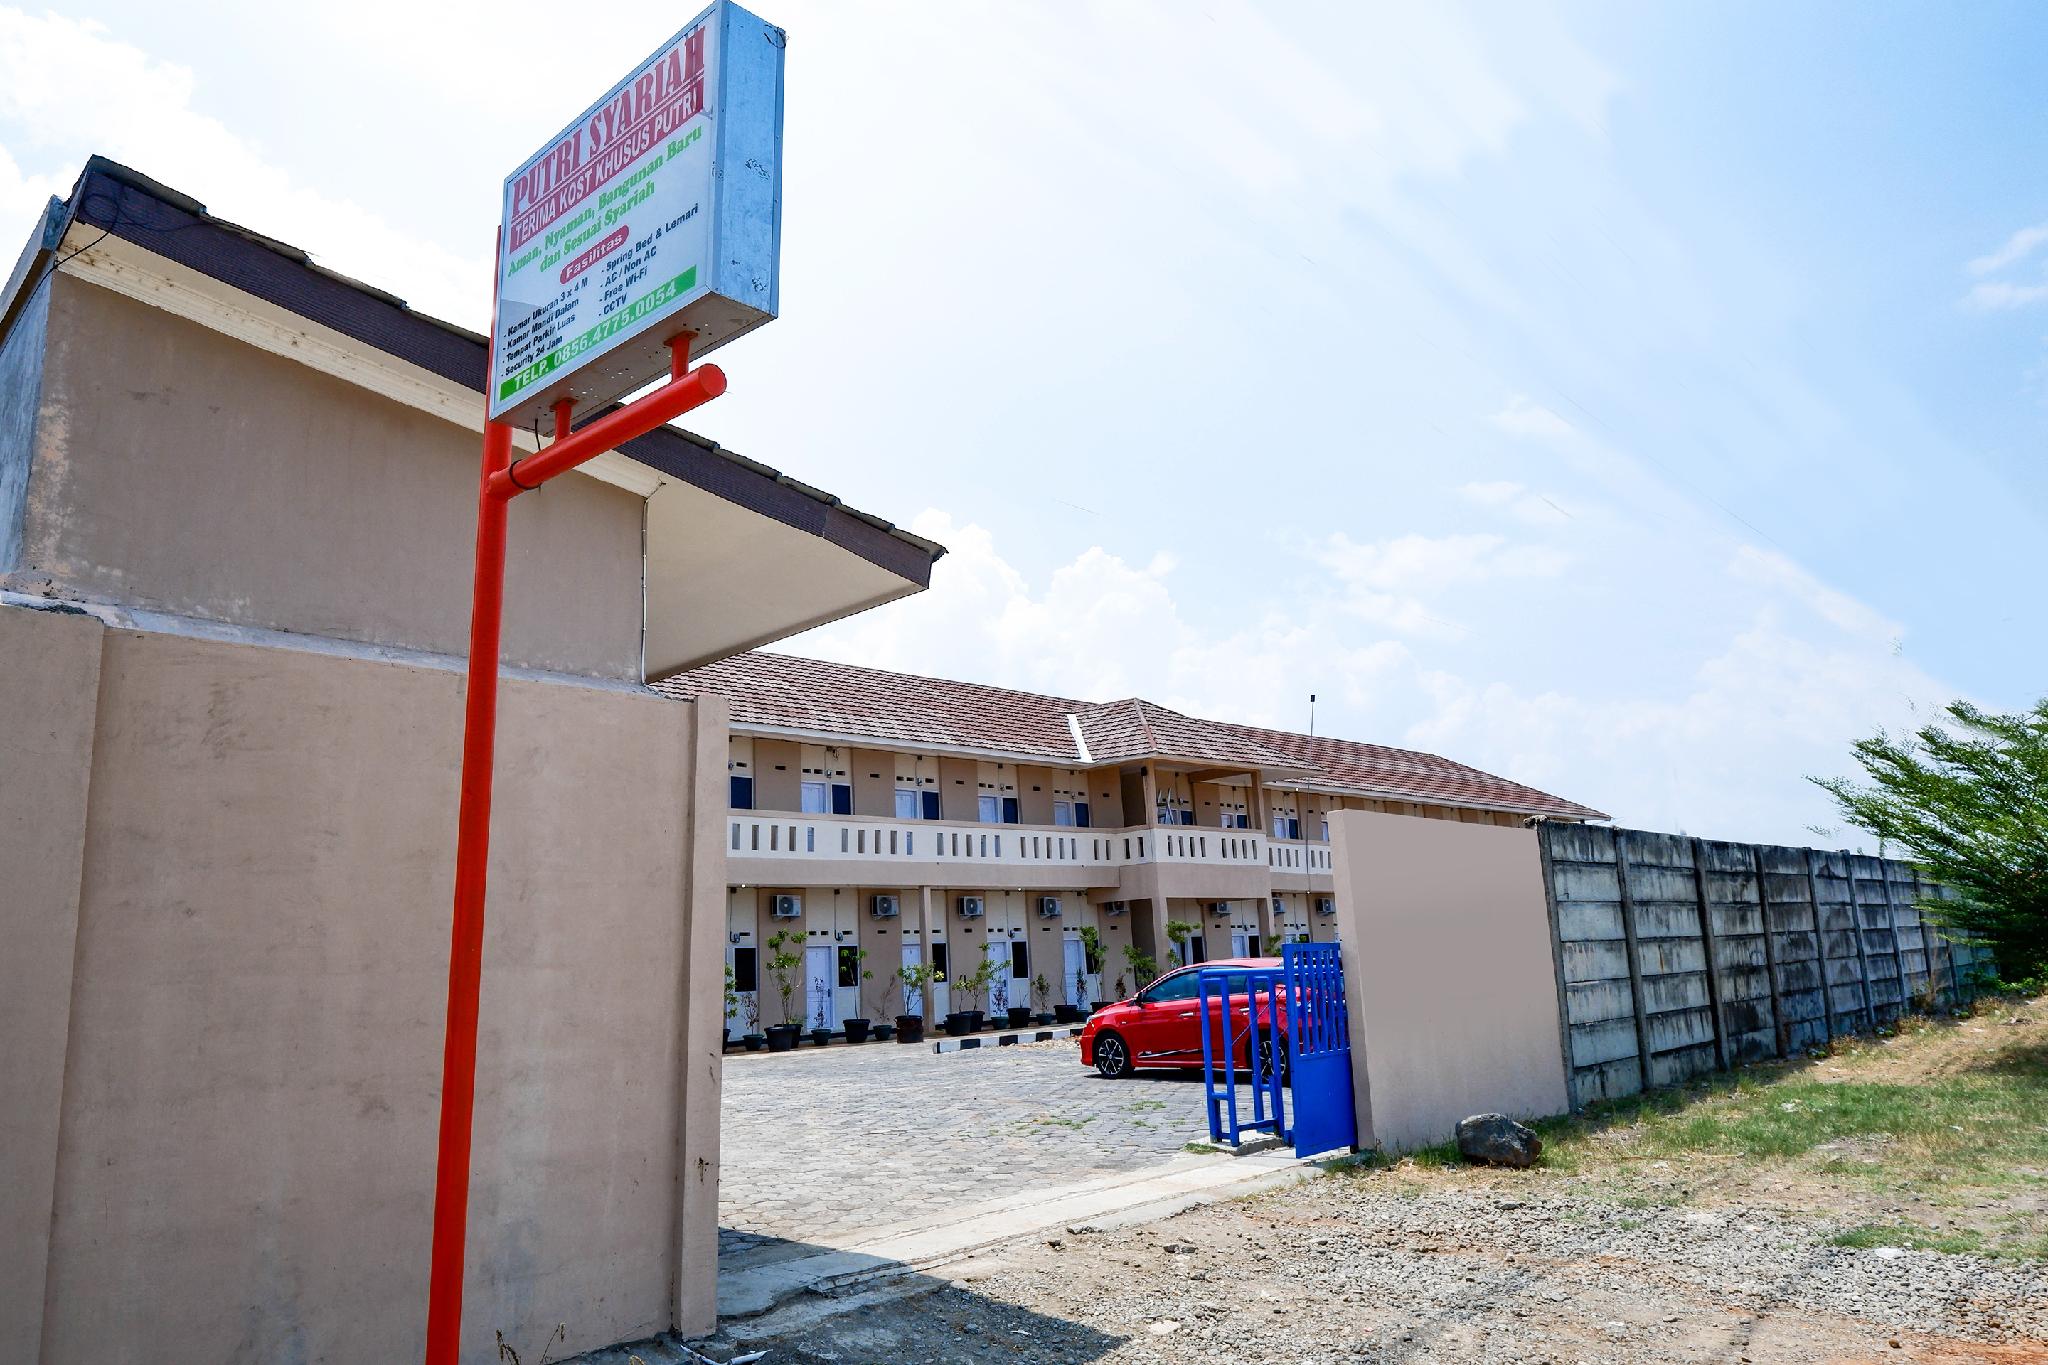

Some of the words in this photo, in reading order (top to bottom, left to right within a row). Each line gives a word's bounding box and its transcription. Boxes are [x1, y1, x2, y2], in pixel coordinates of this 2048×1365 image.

[512, 128, 582, 218] PUTRI
[589, 26, 705, 156] SYARIAH
[515, 199, 555, 243] TERIMA
[559, 170, 592, 213] KOST
[595, 124, 649, 187] KHUSUS
[653, 85, 698, 141] PUTRI
[508, 246, 541, 278] Aman,
[544, 207, 595, 250] Nyaman,
[598, 154, 663, 211] Bangunan
[666, 126, 702, 161] Baru
[539, 250, 560, 273] dan
[563, 215, 602, 255] Sesuai
[604, 181, 655, 226] Syariah
[565, 234, 622, 279] Fasilitas
[606, 249, 633, 272] Spring
[635, 233, 653, 252] Bed
[655, 227, 662, 239] &
[665, 203, 699, 233] Lemari
[604, 272, 617, 287] AC
[624, 257, 641, 275] Non
[644, 246, 656, 262] AC
[604, 284, 623, 302] Free
[625, 266, 648, 287] Wi-Fi
[507, 317, 531, 337] Kamar
[532, 299, 559, 319] Ukuran
[560, 292, 565, 301] 3
[567, 288, 572, 297] x
[574, 282, 579, 291] 4
[581, 277, 588, 288] M
[507, 330, 530, 349] Kamar
[531, 316, 553, 334] Mandi
[555, 299, 579, 319] Dalam
[603, 293, 627, 315] CCTV
[505, 353, 534, 376] Security
[535, 346, 545, 357] 24
[547, 336, 563, 350] Jam
[506, 341, 531, 362] Tempat
[533, 324, 555, 346] Parkir
[557, 314, 576, 331] Luas
[514, 360, 549, 390] TELP.
[554, 280, 676, 368] 0856.4775.0054
